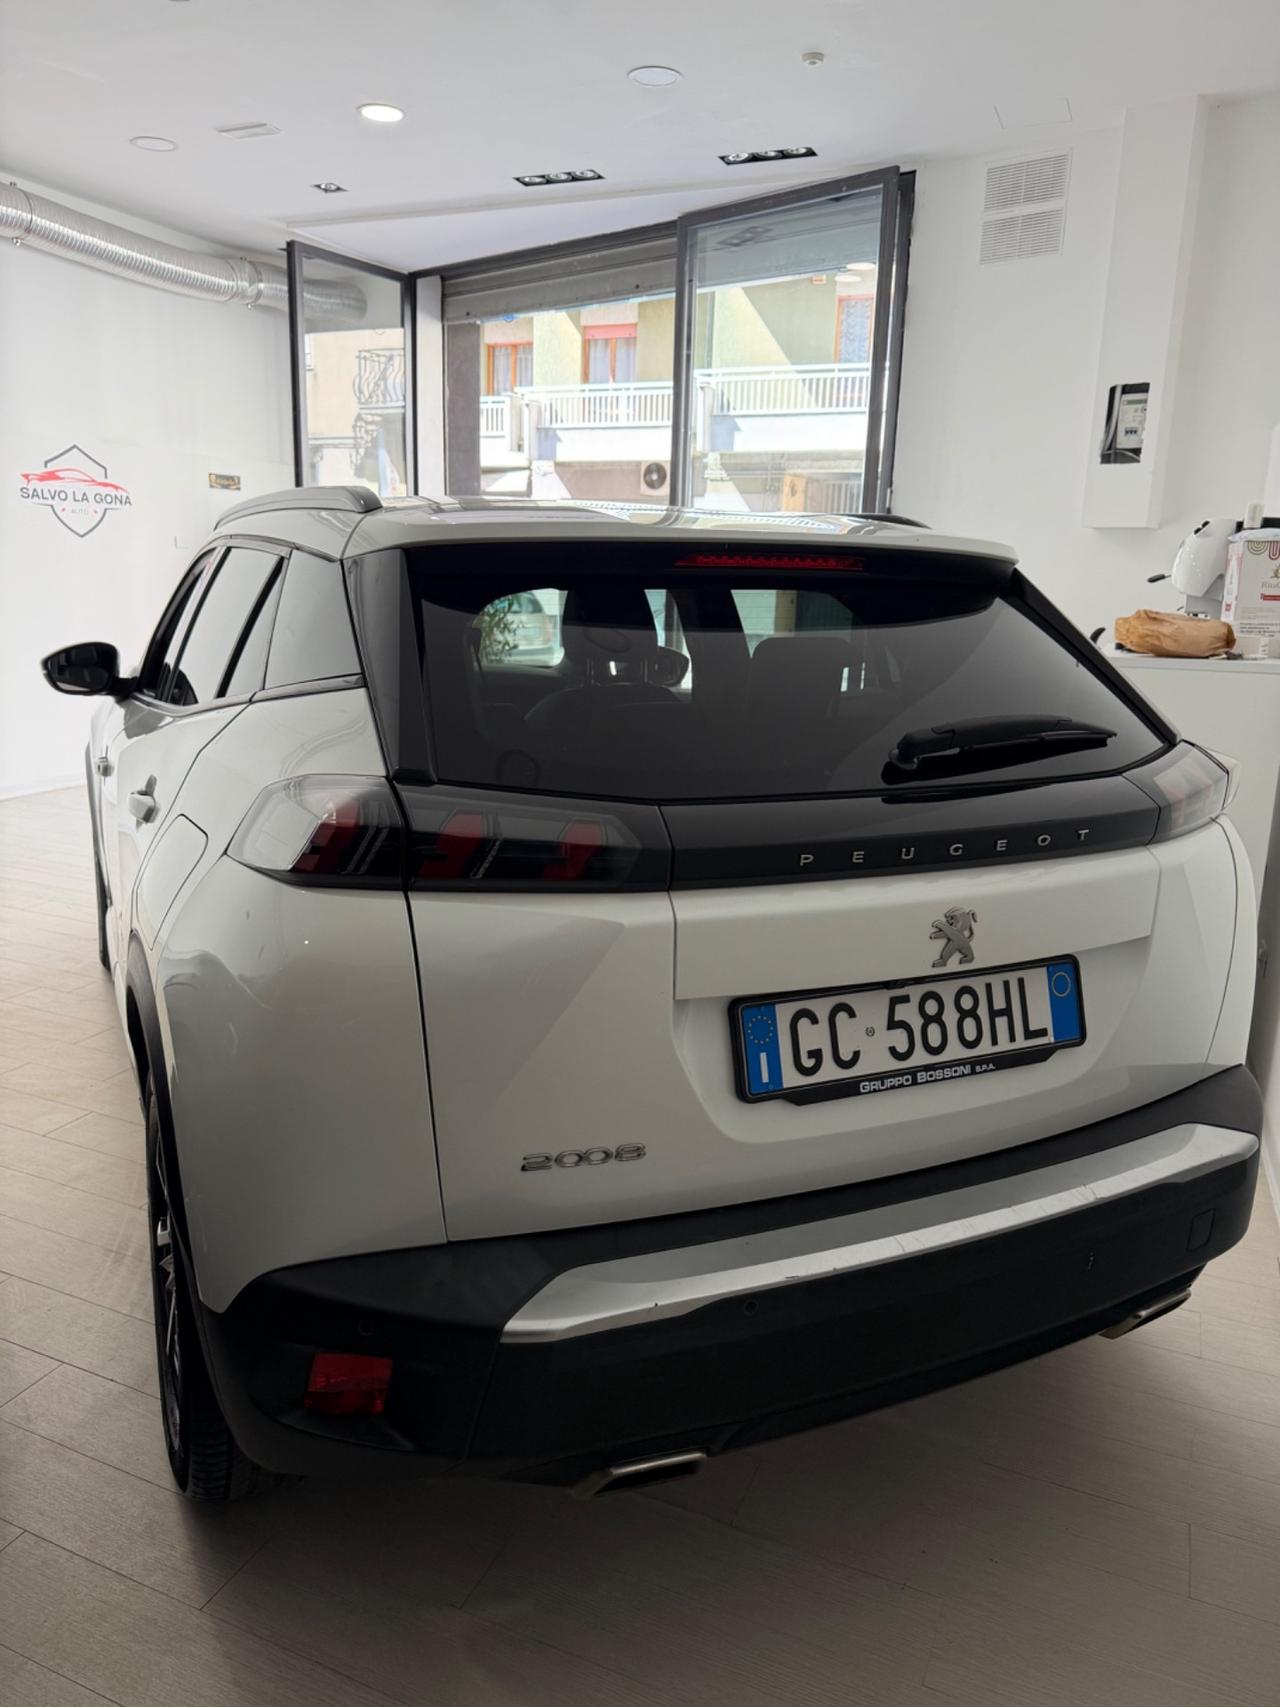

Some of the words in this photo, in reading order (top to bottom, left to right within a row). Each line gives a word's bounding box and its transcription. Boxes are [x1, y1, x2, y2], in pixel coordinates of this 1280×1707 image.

[19, 486, 68, 502] SALVO
[73, 490, 90, 504] LA
[93, 492, 133, 506] GONA
[799, 829, 1090, 867] PEUGEOT
[789, 1002, 861, 1077] GC
[886, 976, 1049, 1062] 588HL
[859, 1074, 913, 1093] GRUPPO
[916, 1064, 972, 1083] BOSSONI
[520, 1142, 647, 1172] 2008
